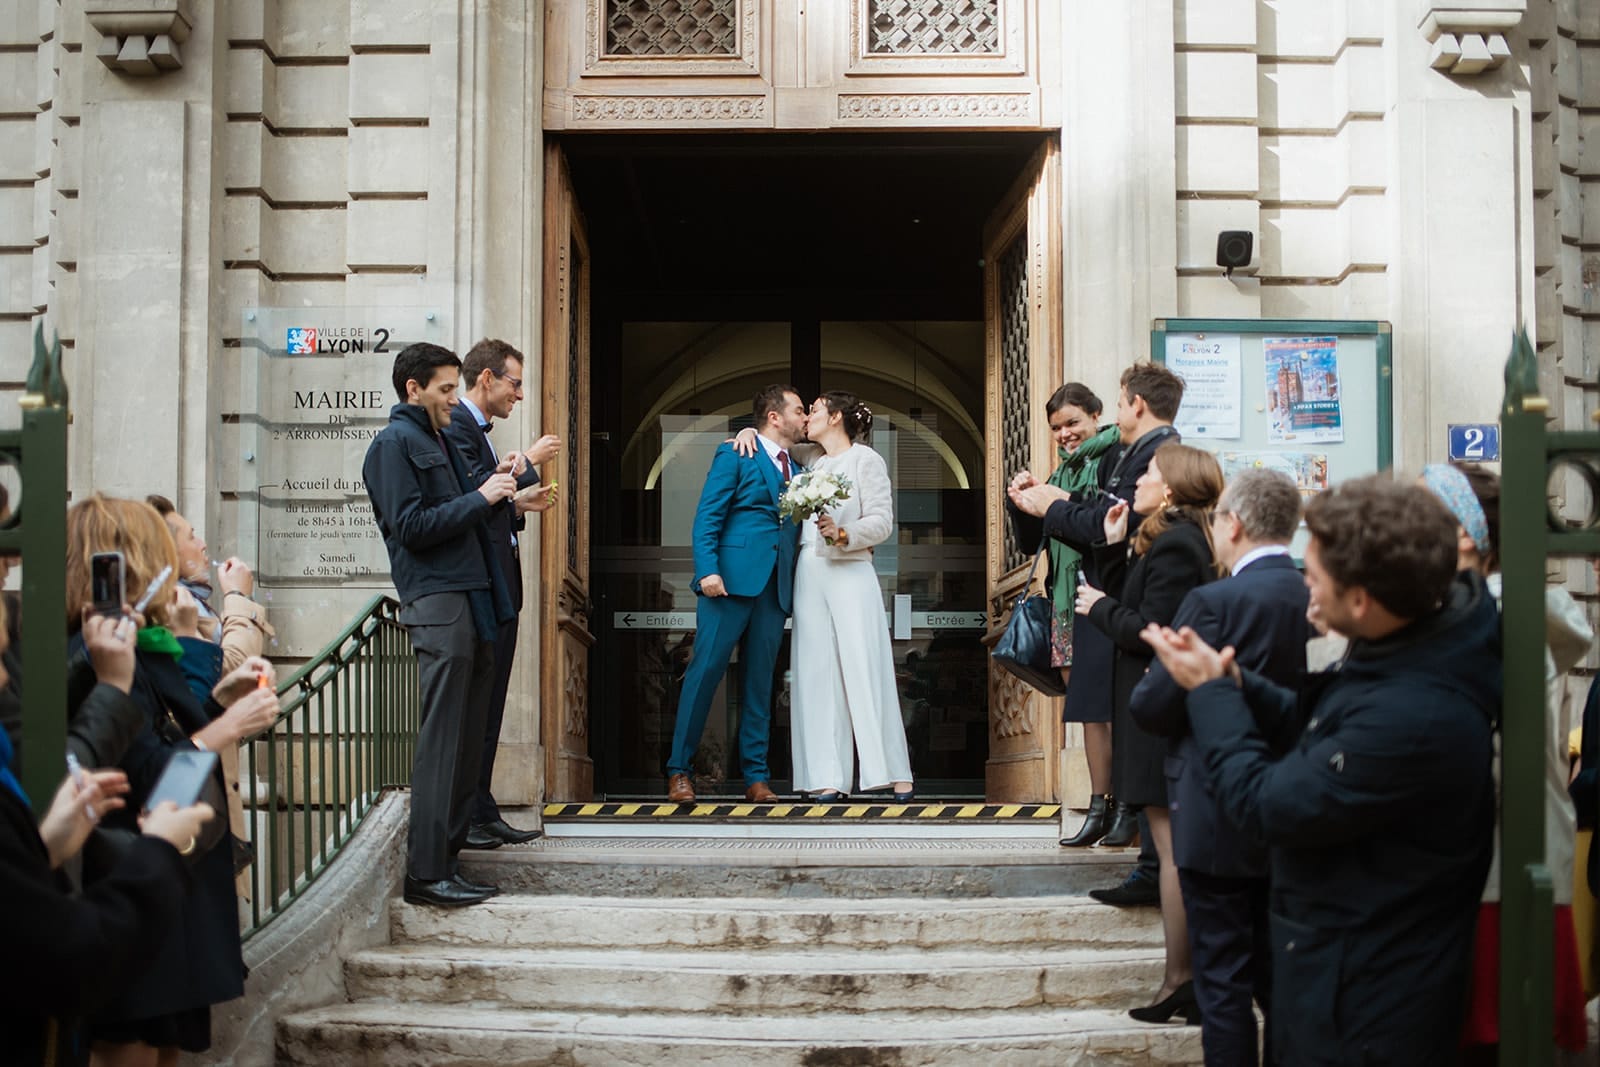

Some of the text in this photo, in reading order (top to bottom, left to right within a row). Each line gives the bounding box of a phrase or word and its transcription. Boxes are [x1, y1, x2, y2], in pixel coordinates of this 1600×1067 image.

[318, 328, 363, 336] VILLE DE
[318, 339, 363, 353] LYON
[294, 391, 383, 408] MAIRIE
[329, 415, 346, 425] DU
[1465, 429, 1483, 456] 2
[282, 478, 329, 490] Accueil
[334, 478, 349, 490] du
[285, 504, 298, 513] du
[301, 504, 330, 513] Lundi
[297, 517, 310, 526] de
[312, 517, 336, 526] 8h45
[339, 517, 345, 526] à
[310, 530, 318, 539] le
[320, 530, 340, 540] jeudi
[342, 531, 362, 539] entre
[319, 553, 355, 562] Samedi
[303, 566, 314, 576] de
[317, 566, 343, 576] 9h30
[354, 566, 372, 576] 12h
[646, 615, 684, 626] Entrée
